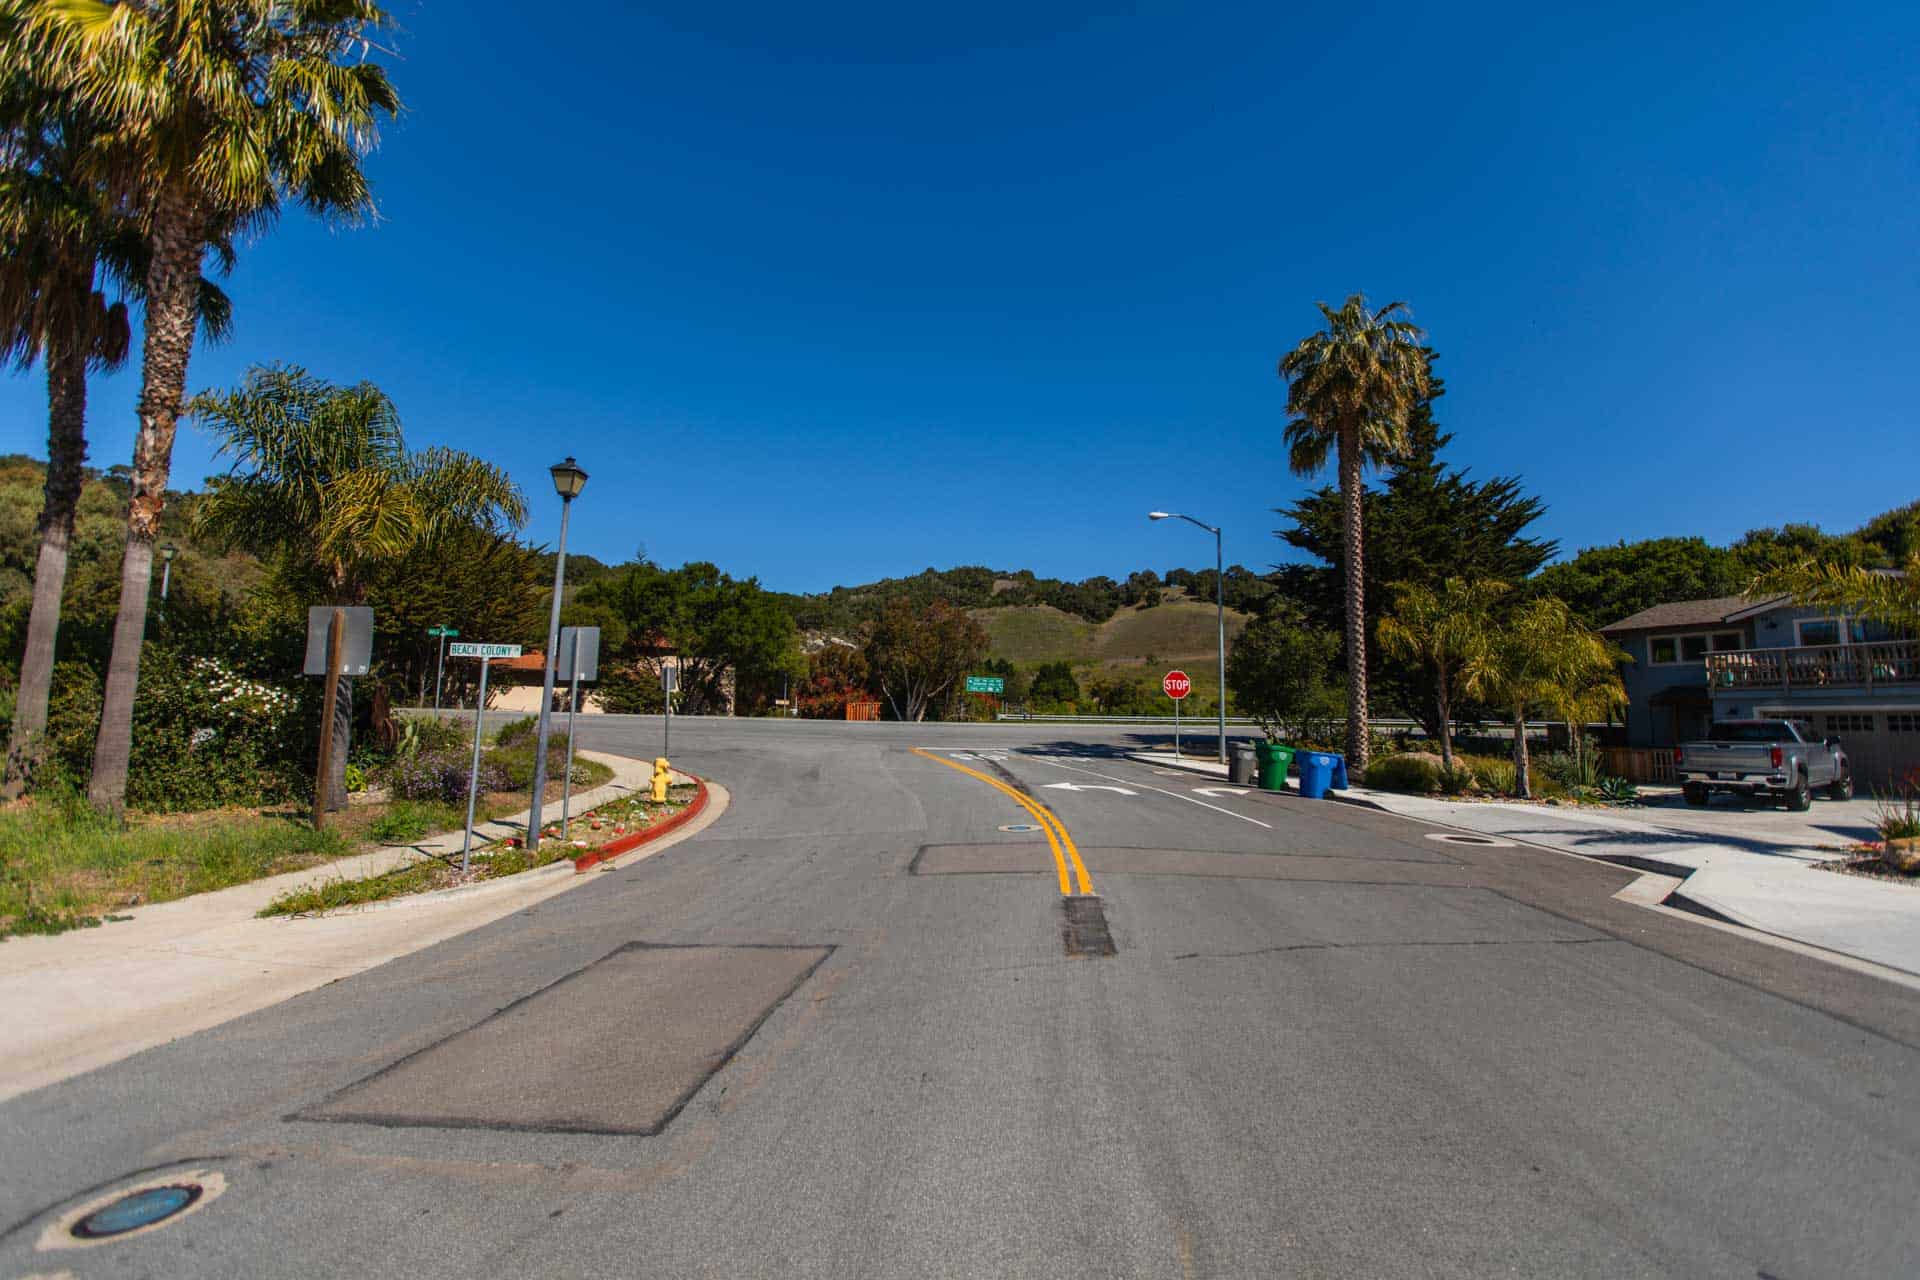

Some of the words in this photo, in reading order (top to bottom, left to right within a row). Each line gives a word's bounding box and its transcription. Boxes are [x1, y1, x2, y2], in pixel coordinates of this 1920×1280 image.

[452, 645, 478, 655] BEACH
[481, 646, 512, 656] COLONY
[1166, 680, 1189, 691] STOP
